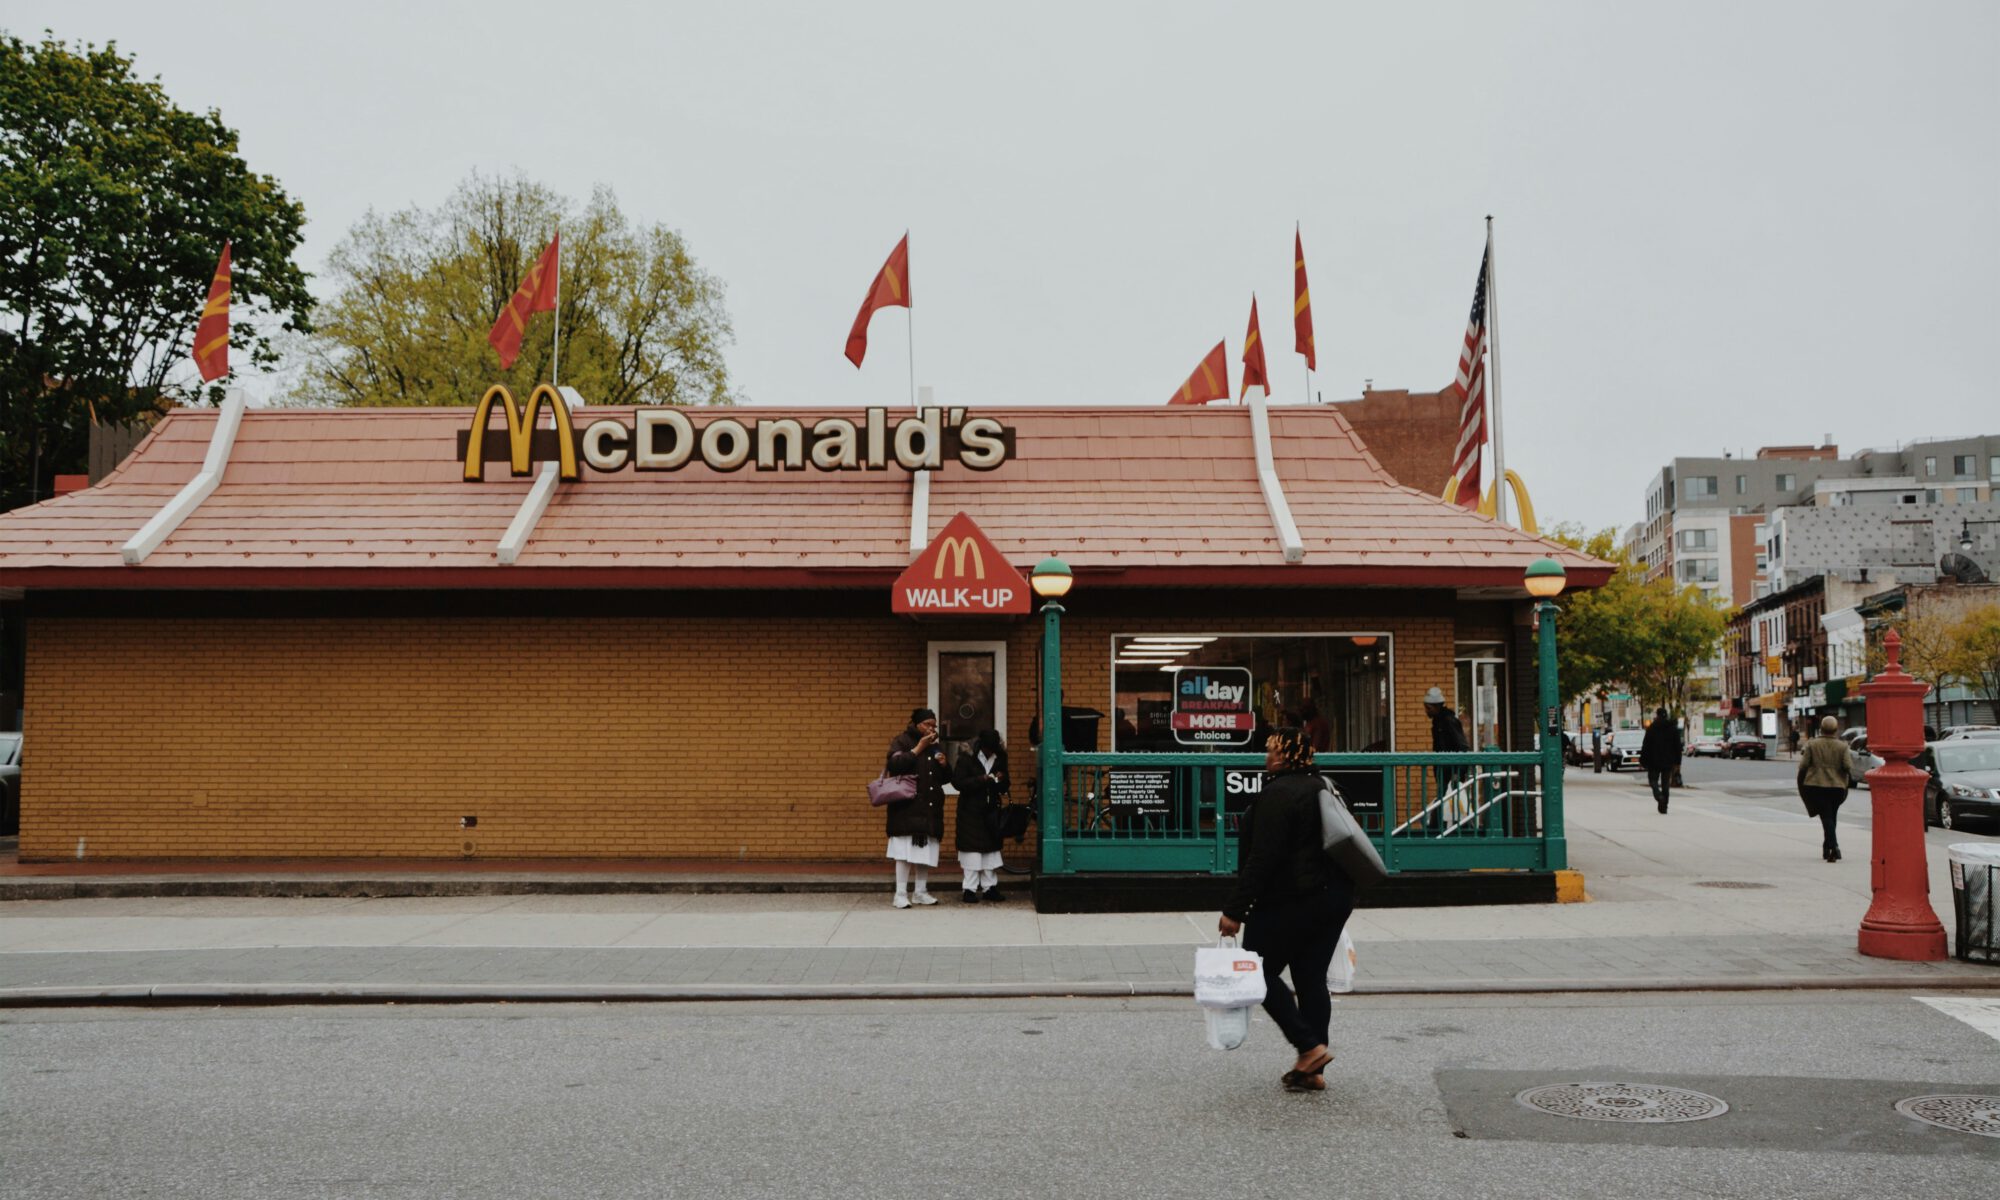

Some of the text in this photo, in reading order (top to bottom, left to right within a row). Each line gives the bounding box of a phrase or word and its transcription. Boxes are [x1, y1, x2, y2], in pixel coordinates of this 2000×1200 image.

[463, 383, 1008, 482] McDonald's
[905, 587, 1013, 608] WALK-UP
[1181, 676, 1244, 703] all day
[1181, 701, 1243, 710] BREAKFAST
[1189, 714, 1236, 728] MORE
[1194, 731, 1231, 740] choices
